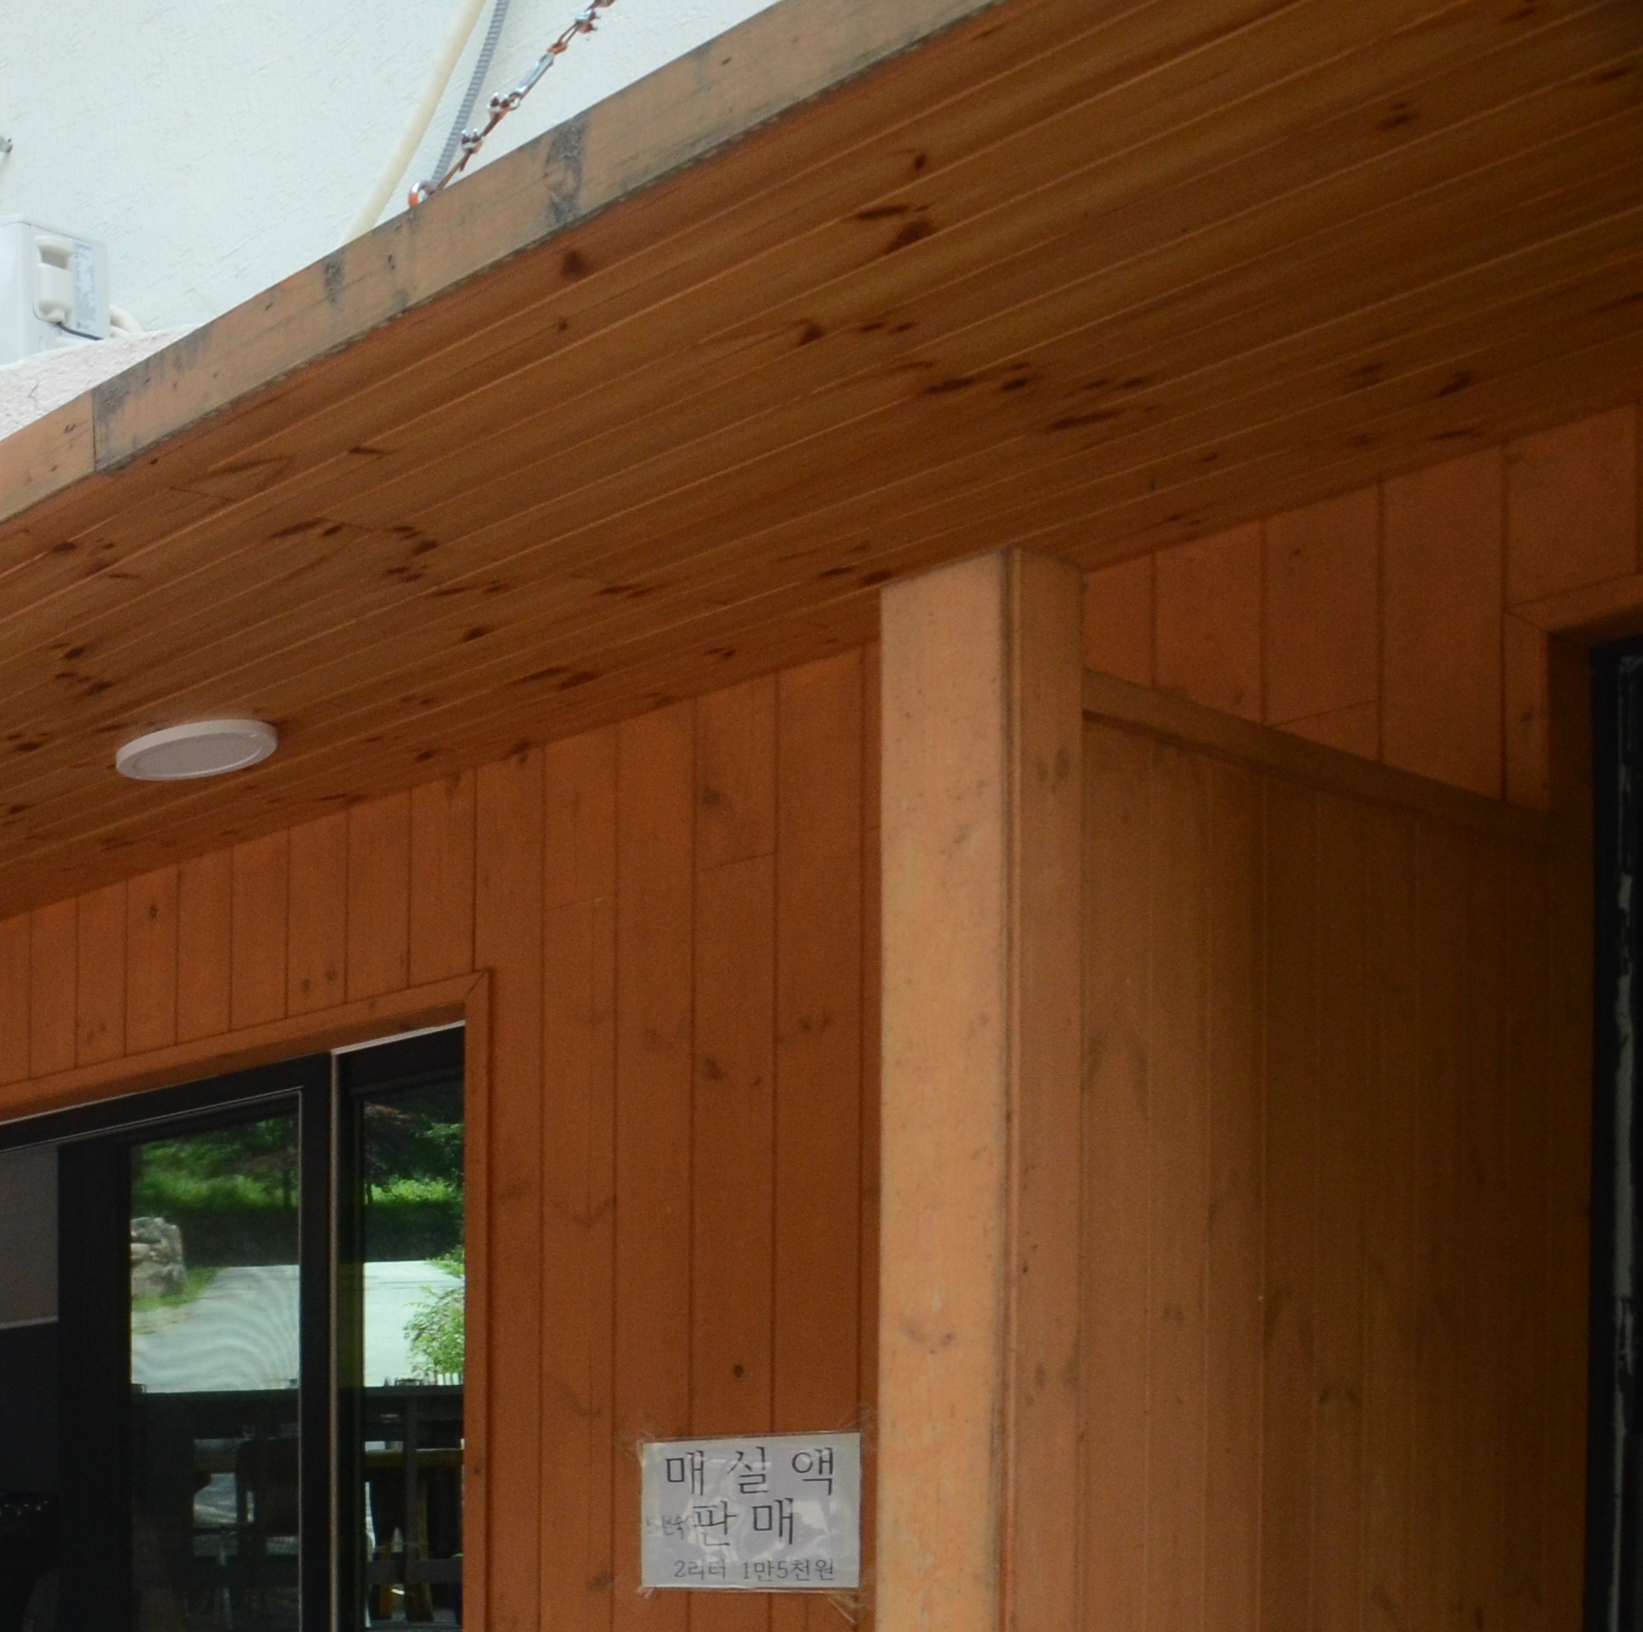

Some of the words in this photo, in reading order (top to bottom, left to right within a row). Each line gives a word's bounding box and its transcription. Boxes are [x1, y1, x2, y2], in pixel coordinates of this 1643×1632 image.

[666, 1446, 834, 1496] 매실액
[692, 1497, 794, 1547] 판매
[674, 1558, 727, 1580] 2리터
[743, 1558, 835, 1582] 1만5천원
